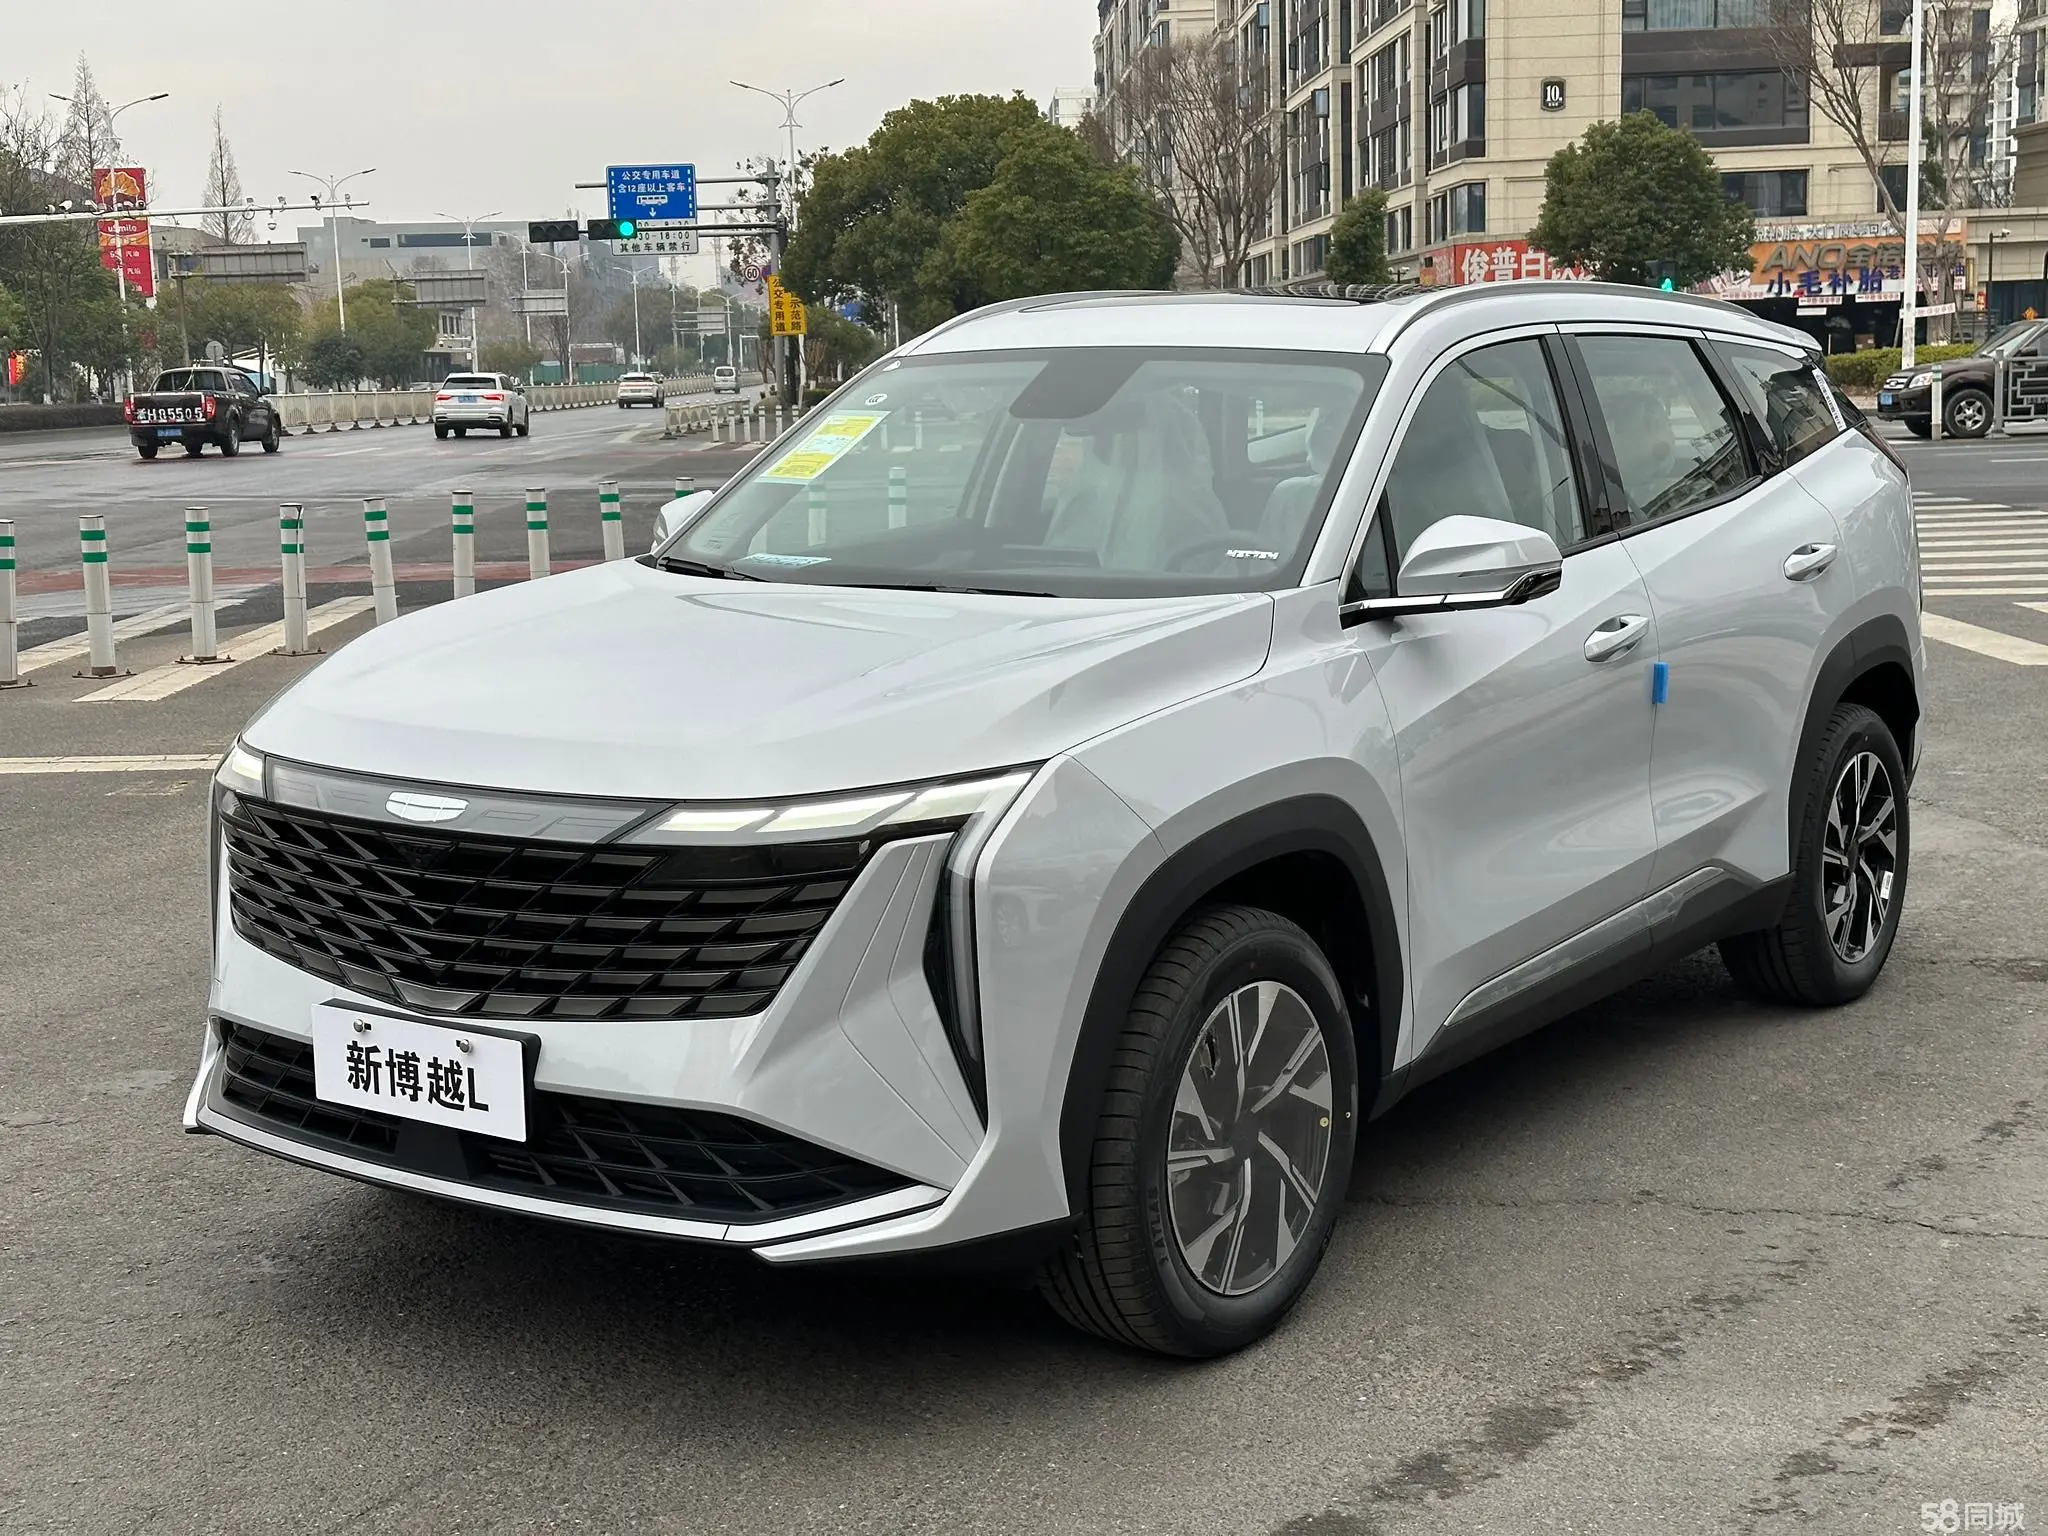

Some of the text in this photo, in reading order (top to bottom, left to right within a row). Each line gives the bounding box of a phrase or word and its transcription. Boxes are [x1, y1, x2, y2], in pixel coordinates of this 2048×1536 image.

[621, 169, 680, 181] 公交专用车道
[618, 182, 686, 193] 含12座以上客车
[620, 241, 690, 253] 其他车辆禁行
[746, 268, 758, 279] 60
[1767, 265, 1884, 297] 小毛补胎
[773, 278, 786, 332] 公交专用道
[346, 1040, 490, 1113] 新博越L
